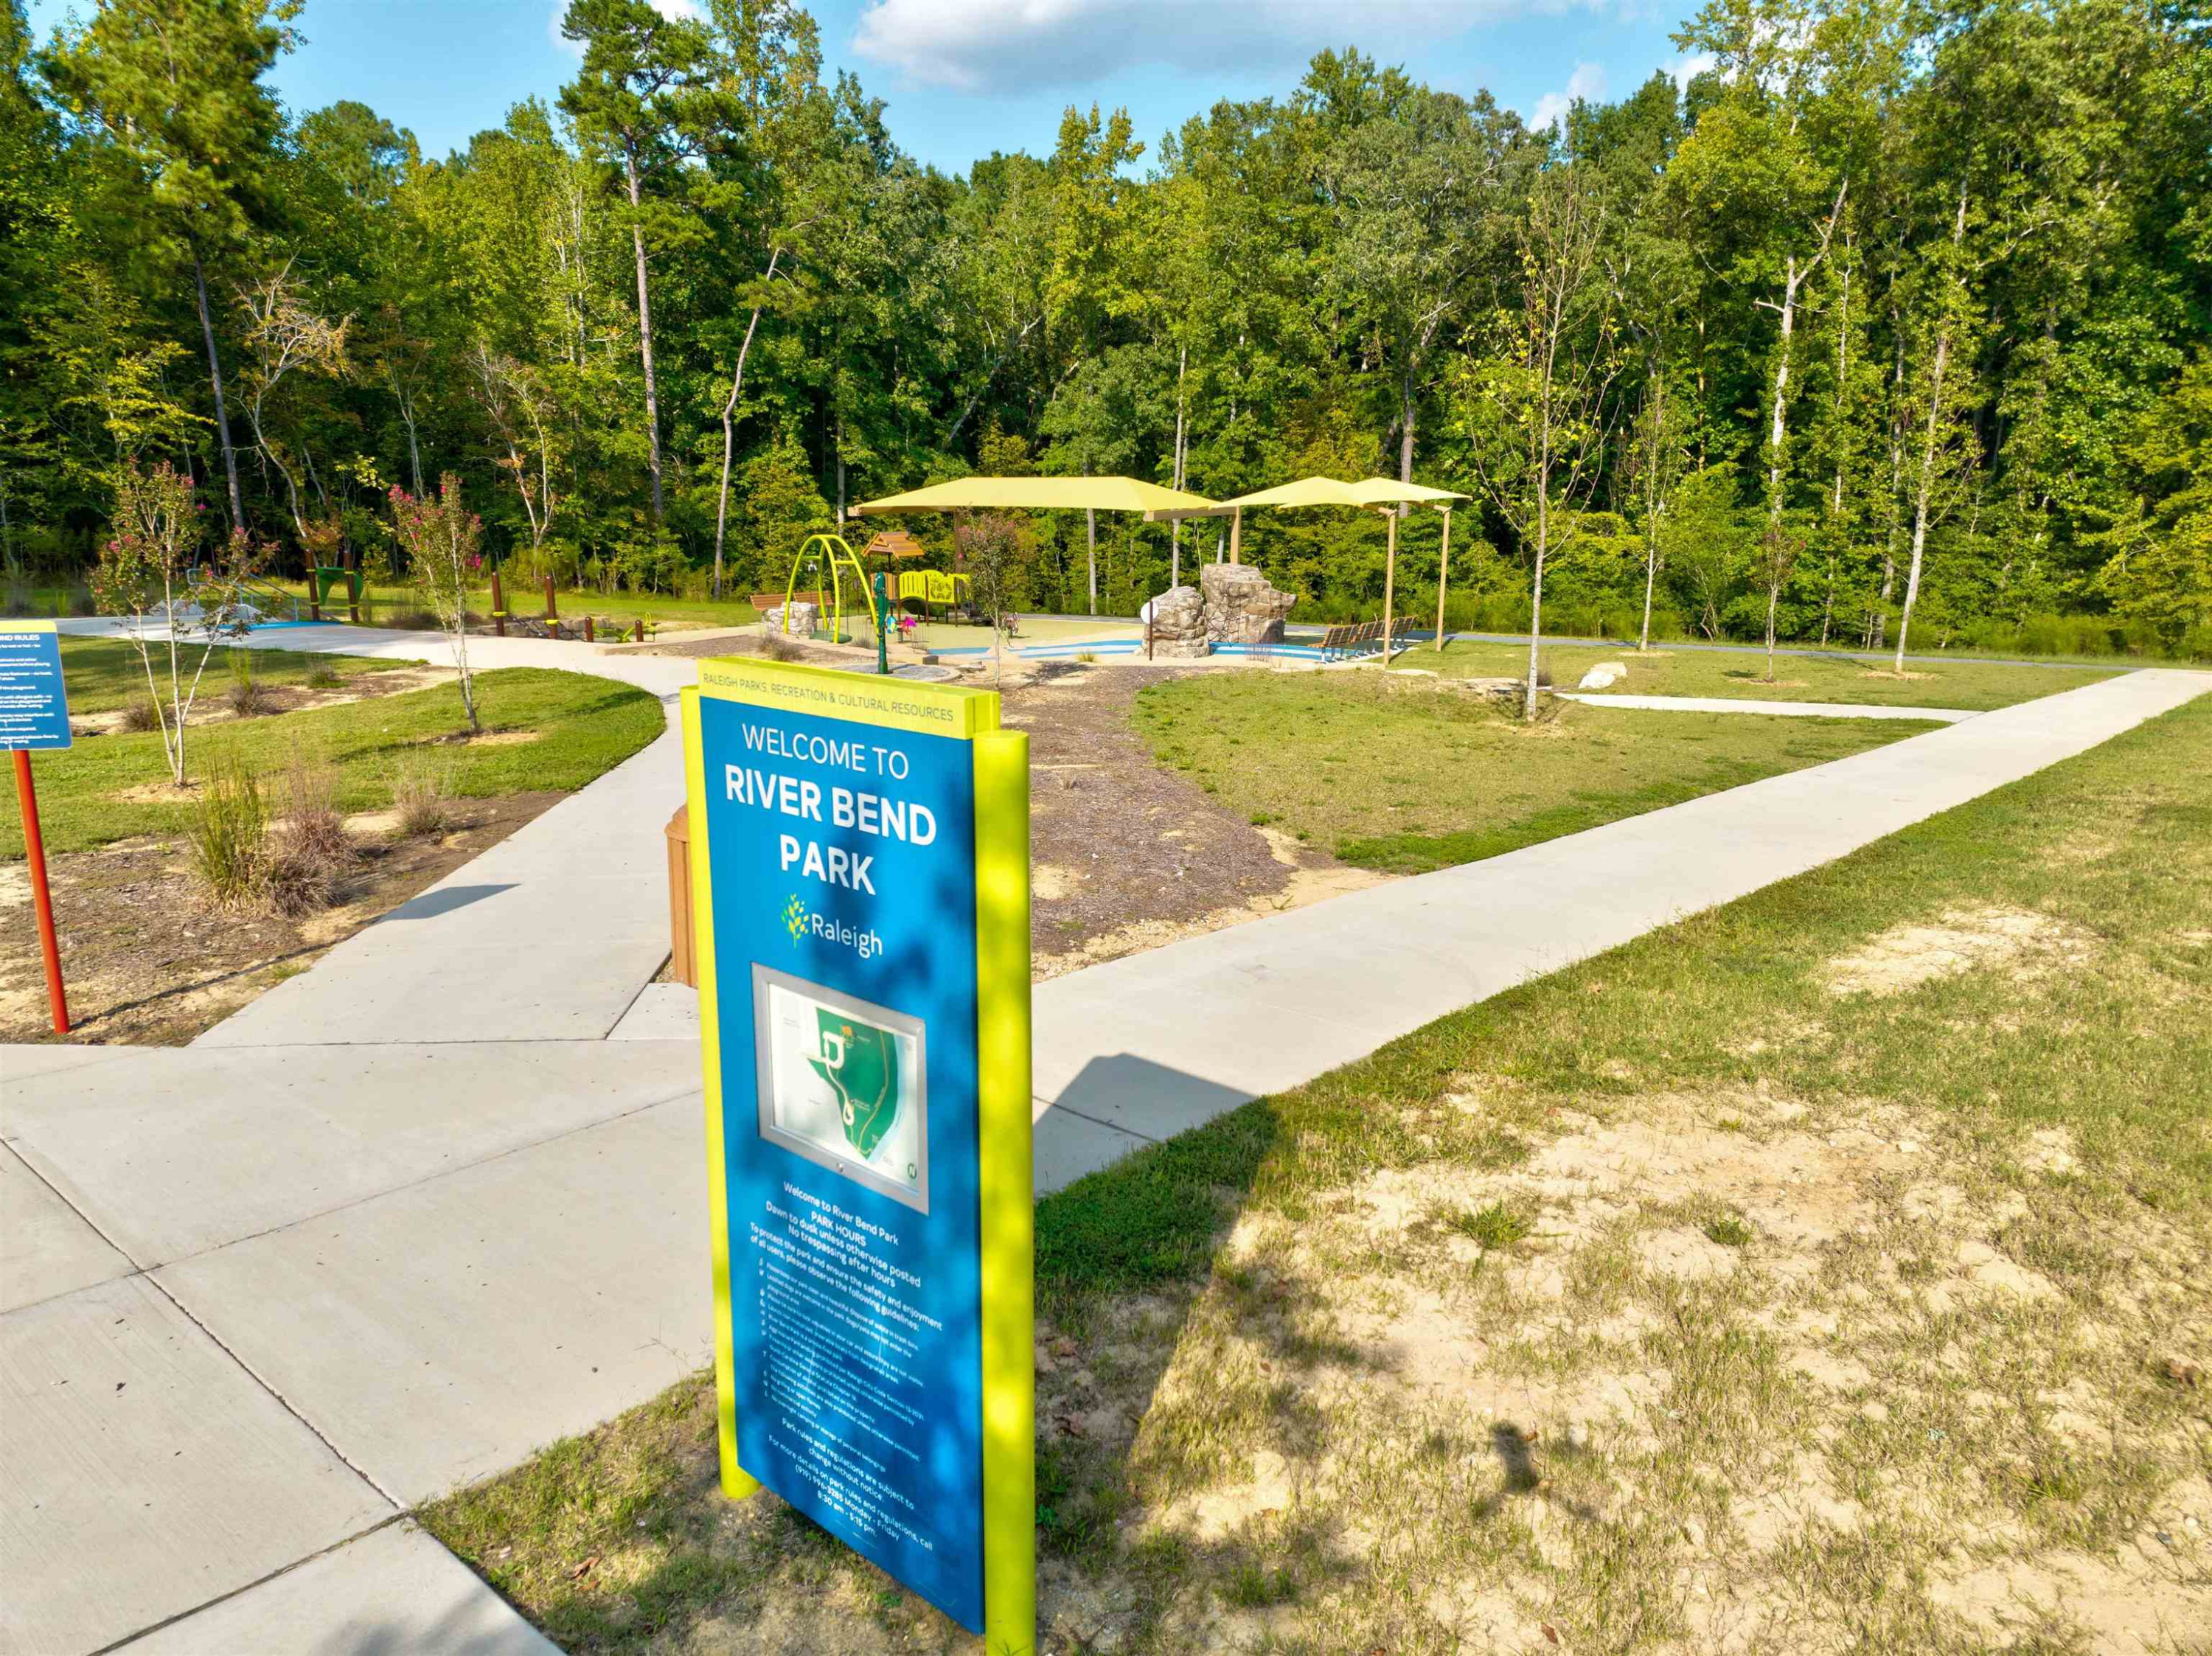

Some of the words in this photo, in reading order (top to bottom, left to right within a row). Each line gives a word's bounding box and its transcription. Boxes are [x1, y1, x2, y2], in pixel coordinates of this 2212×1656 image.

[703, 674, 737, 687] RALEIGH
[738, 678, 769, 692] PARKS,
[771, 683, 828, 703] RECREATION
[829, 693, 836, 703] &
[838, 695, 889, 712] CULTURAL
[891, 702, 954, 722] RESOURCES
[742, 723, 866, 773] WELCOME
[872, 747, 909, 780] TO
[726, 764, 822, 823] RIVER
[832, 787, 937, 846] BEND
[779, 835, 877, 896] PARK
[812, 912, 883, 959] Raleigh
[784, 1180, 819, 1208] Welcome
[821, 1199, 830, 1213] to
[832, 1204, 852, 1224] River
[855, 1215, 877, 1236] Bend
[879, 1226, 898, 1246] Park
[811, 1211, 833, 1231] PARK
[835, 1222, 866, 1247] HOURS
[766, 1200, 787, 1220] Dawn
[789, 1212, 798, 1225] to
[799, 1217, 818, 1236] dusk
[819, 1230, 844, 1249] unless
[846, 1243, 887, 1271] otherwise
[890, 1265, 920, 1288] posted
[788, 1224, 799, 1238] No
[801, 1231, 846, 1265] trespassing
[849, 1257, 869, 1274] after
[871, 1267, 894, 1288] hours
[750, 1221, 757, 1234] To
[784, 1239, 794, 1253] the
[796, 1248, 810, 1262] park
[813, 1256, 824, 1269] and
[850, 1273, 861, 1288] the
[863, 1283, 885, 1304] safety
[887, 1295, 900, 1309] and
[902, 1304, 942, 1331] enjoyment
[835, 1278, 846, 1293] the
[849, 1286, 880, 1313] following
[768, 1433, 779, 1447] For
[780, 1443, 796, 1458] more
[797, 1453, 818, 1474] details
[820, 1469, 827, 1480] on
[829, 1476, 844, 1491] park
[845, 1487, 861, 1503] rules
[863, 1499, 875, 1512] and
[920, 1537, 932, 1551] call
[782, 1417, 796, 1433] Park
[797, 1429, 812, 1444] rules
[814, 1439, 826, 1453] and
[827, 1448, 863, 1478] regulations
[866, 1473, 876, 1486] are
[878, 1481, 903, 1503] subject
[905, 1497, 914, 1511] to
[809, 1448, 830, 1467] change
[832, 1464, 858, 1486] without
[833, 1503, 844, 1514] am
[844, 1497, 871, 1524] Monday
[877, 1519, 899, 1542] Friday
